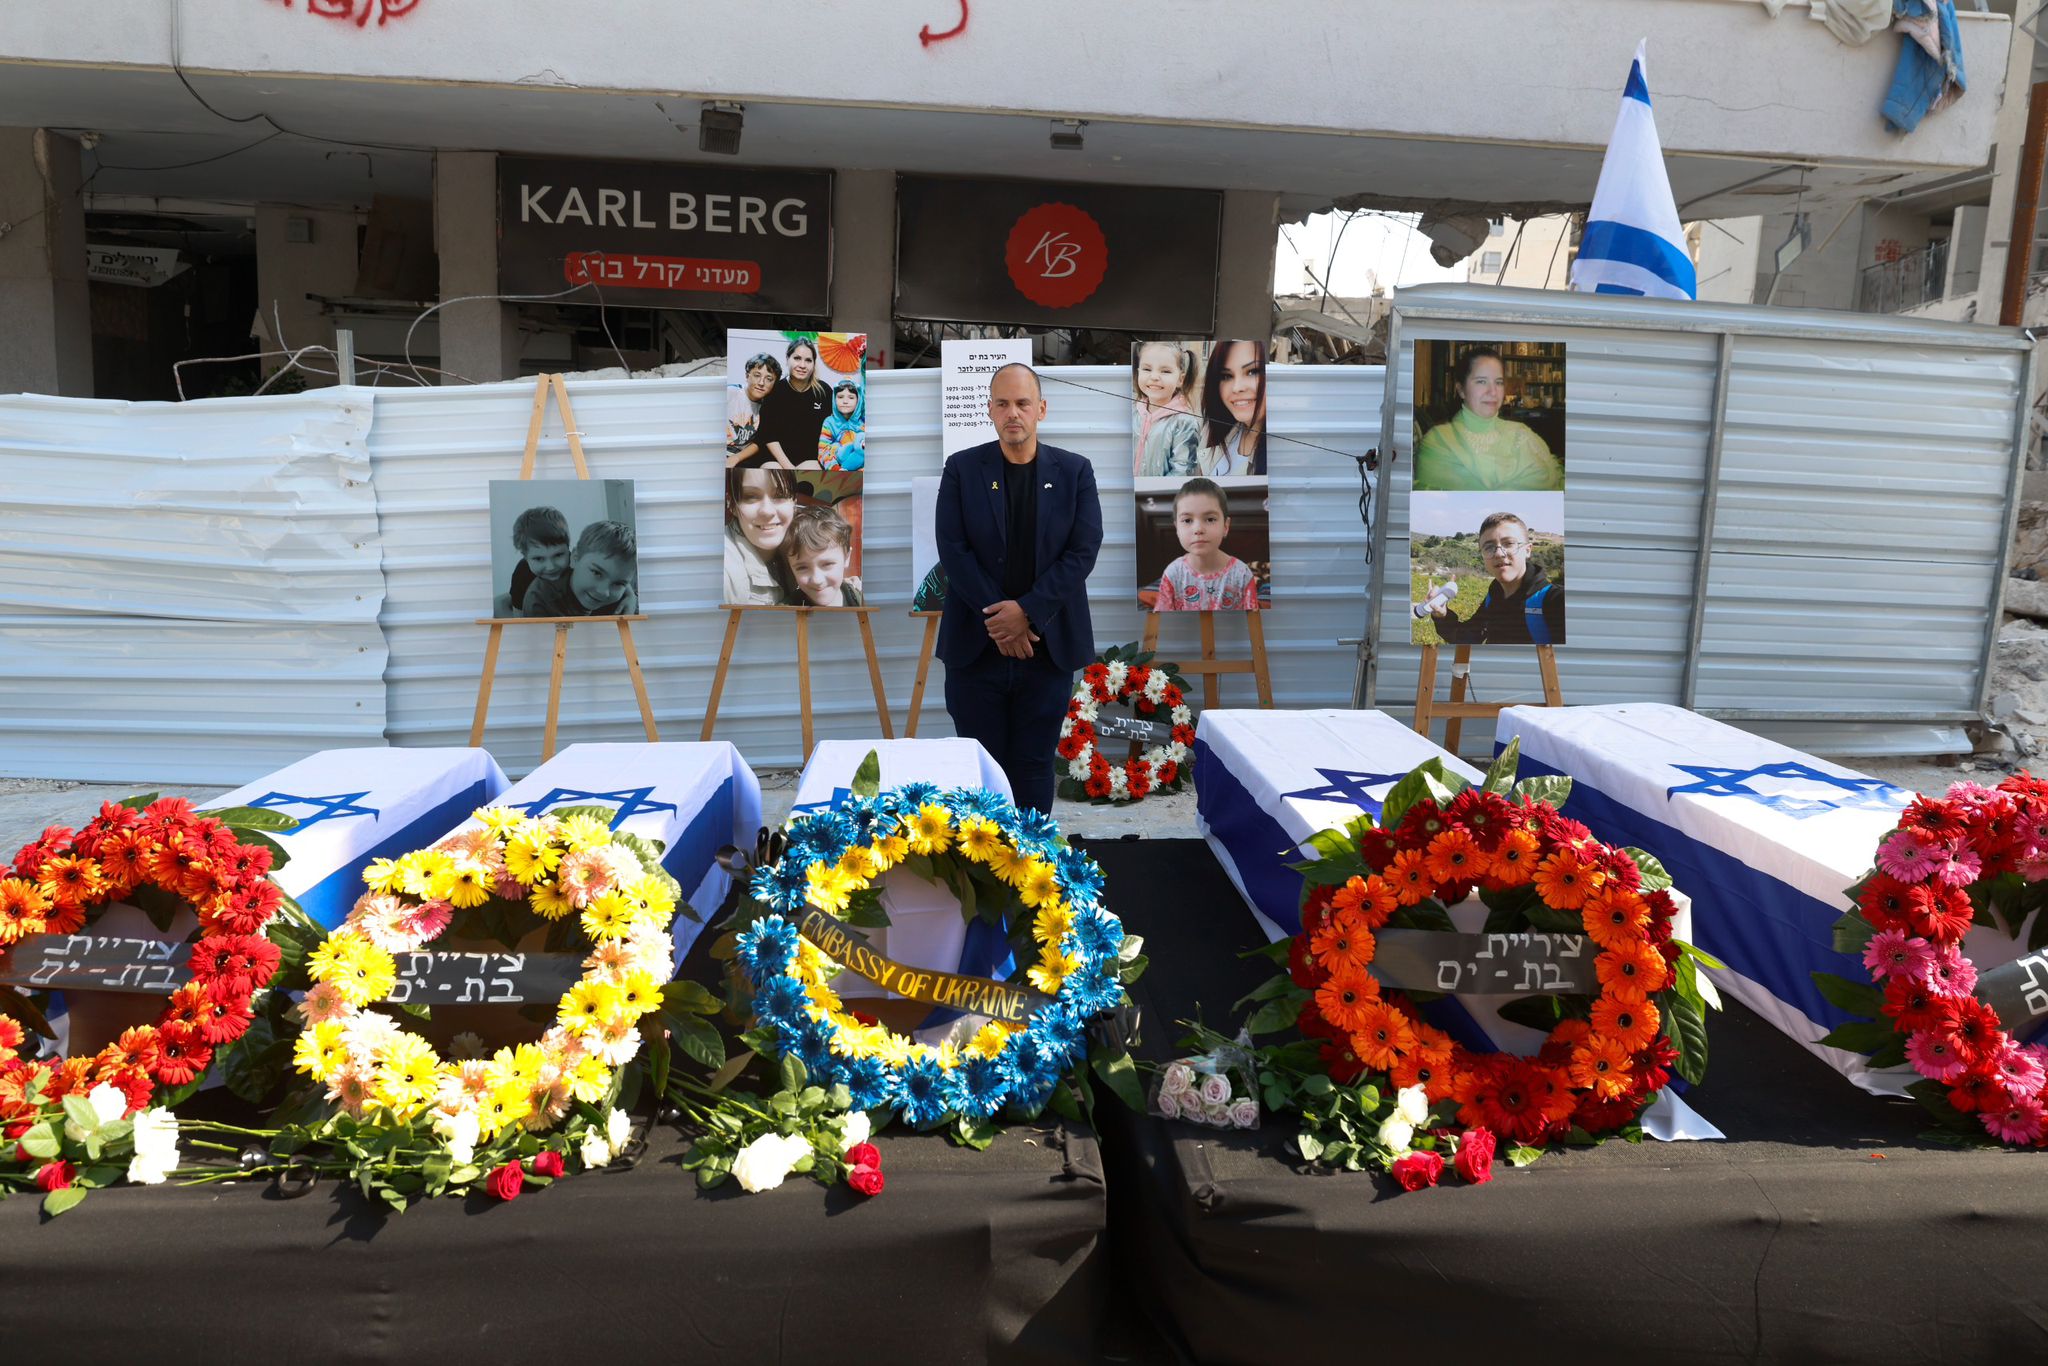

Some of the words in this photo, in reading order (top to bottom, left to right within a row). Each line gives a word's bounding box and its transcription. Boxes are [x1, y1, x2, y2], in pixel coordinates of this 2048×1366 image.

[521, 184, 656, 229] KARL
[669, 192, 808, 237] BERG
[577, 259, 624, 279] ברג
[632, 256, 685, 288] קרל
[1025, 231, 1082, 278] KB
[696, 267, 749, 286] מעדני
[802, 911, 896, 987] EMBASSY
[897, 971, 931, 998] OF
[932, 976, 1028, 1020] UKRAINE
